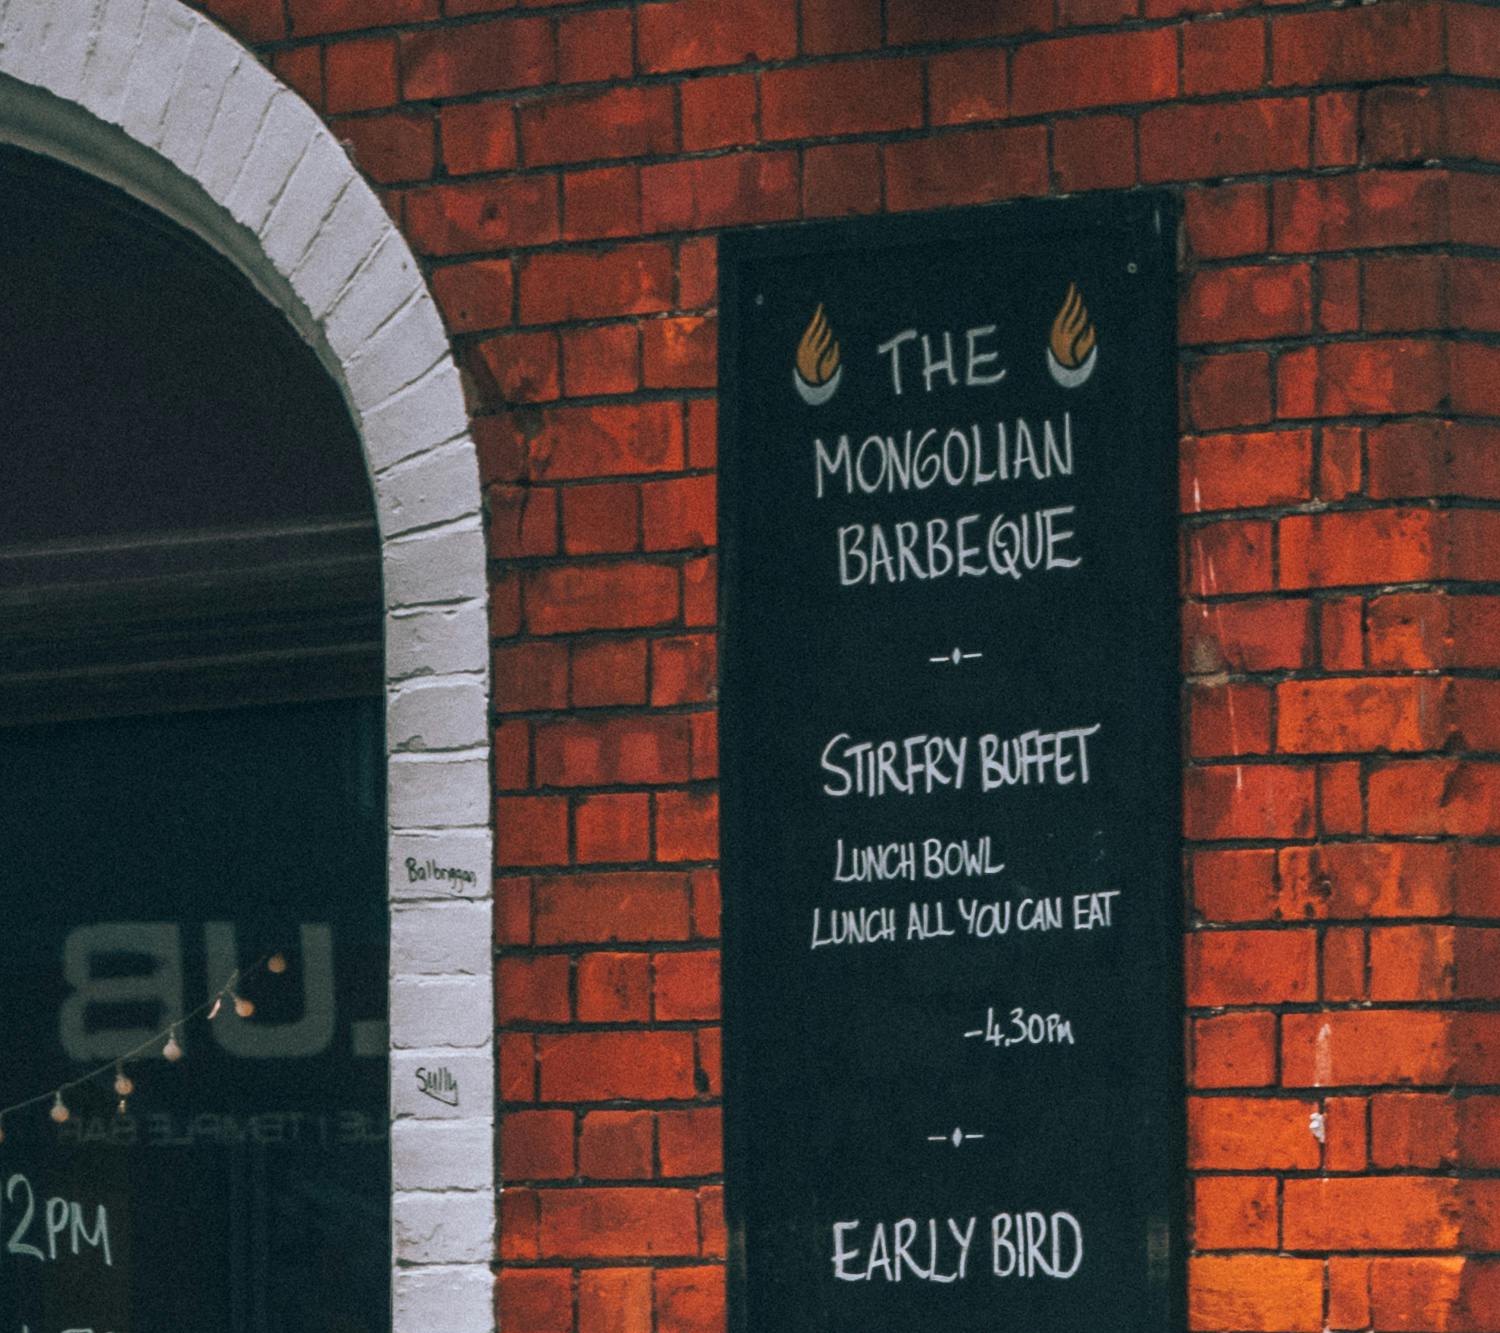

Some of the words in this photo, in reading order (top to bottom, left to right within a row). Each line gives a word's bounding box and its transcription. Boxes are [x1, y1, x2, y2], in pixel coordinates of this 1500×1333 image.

[878, 325, 1006, 394] THE
[814, 413, 1074, 499] MONGOLIAN
[838, 507, 1082, 586] BARBEQUE
[979, 724, 1102, 789] BUFFET
[834, 837, 917, 884] LUNCH
[923, 834, 1005, 879] BOWL
[811, 897, 896, 949] LUNCH
[906, 901, 955, 940] ALL
[957, 896, 1012, 937] YOU
[1016, 895, 1064, 932] CAN
[1073, 890, 1121, 930] EAT
[830, 1216, 977, 1284] EARLY
[990, 1210, 1083, 1280] BIRD
